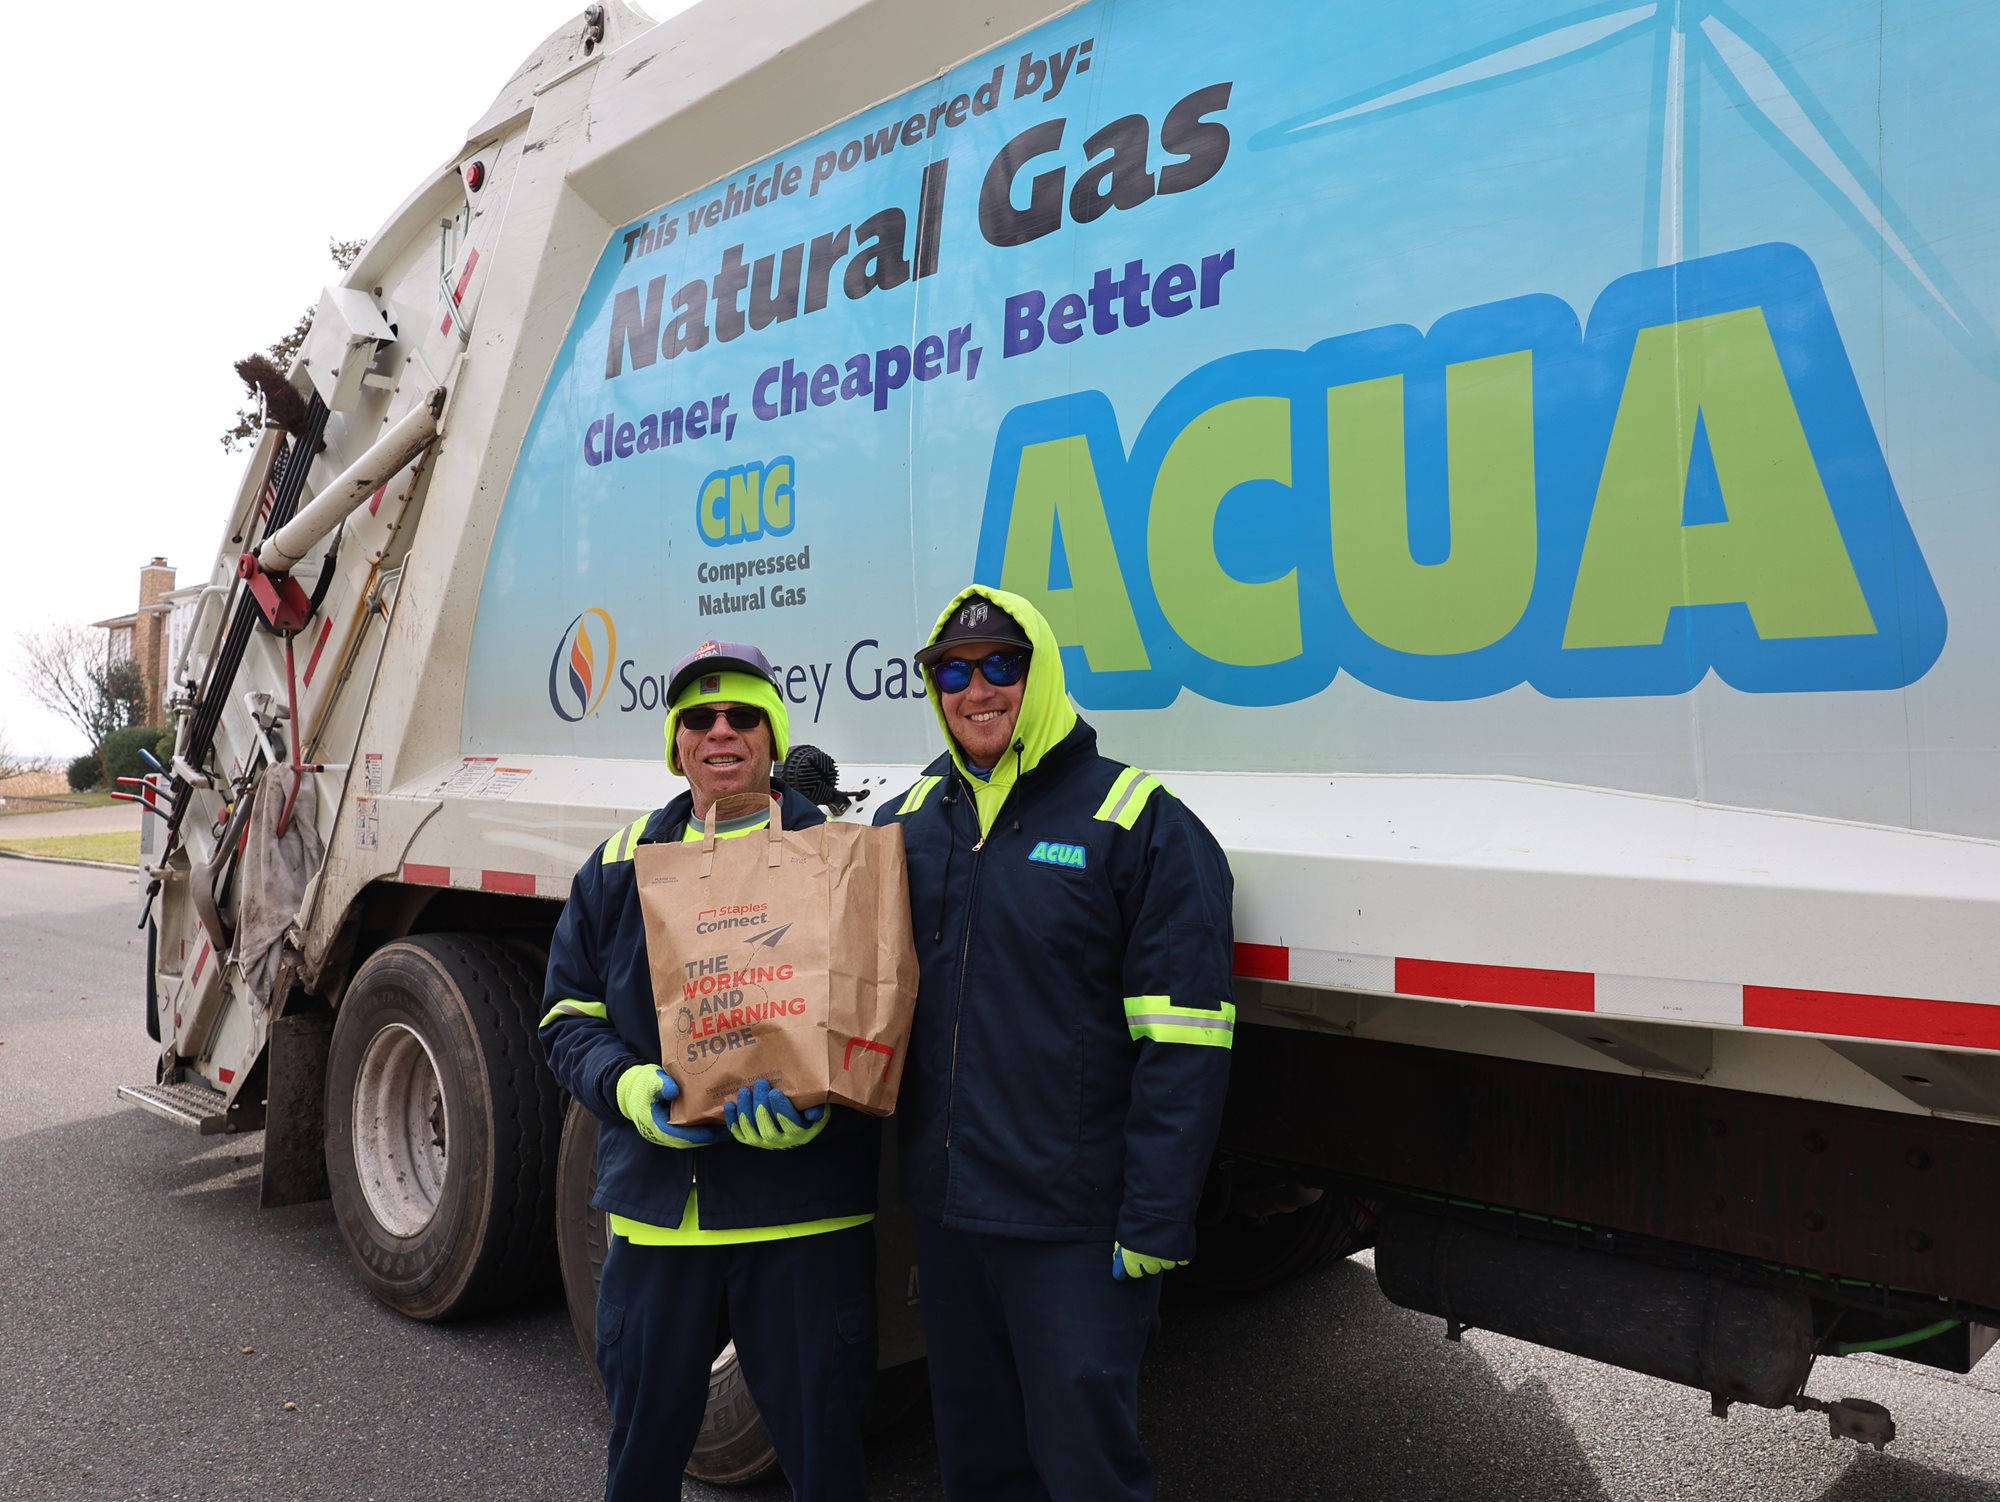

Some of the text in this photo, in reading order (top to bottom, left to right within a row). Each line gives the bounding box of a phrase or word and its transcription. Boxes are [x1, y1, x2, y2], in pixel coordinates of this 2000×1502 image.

[621, 37, 1095, 265] This vehicle powered by:
[604, 81, 1233, 380] Natural Gas
[582, 248, 1236, 467] Cleaner, Cheaper, Better
[699, 462, 791, 542] CNG
[998, 304, 1880, 675] ACUA
[697, 544, 811, 586] Compressed
[698, 584, 807, 617] Natural Gas
[1030, 842, 1085, 868] ACUA
[695, 912, 769, 936] Connect
[718, 902, 769, 917] Staples
[682, 963, 794, 1002] WORKING
[685, 954, 729, 980] THE
[690, 996, 807, 1040] LEARNING
[698, 987, 745, 1018] AND
[686, 1028, 757, 1063] STORE
